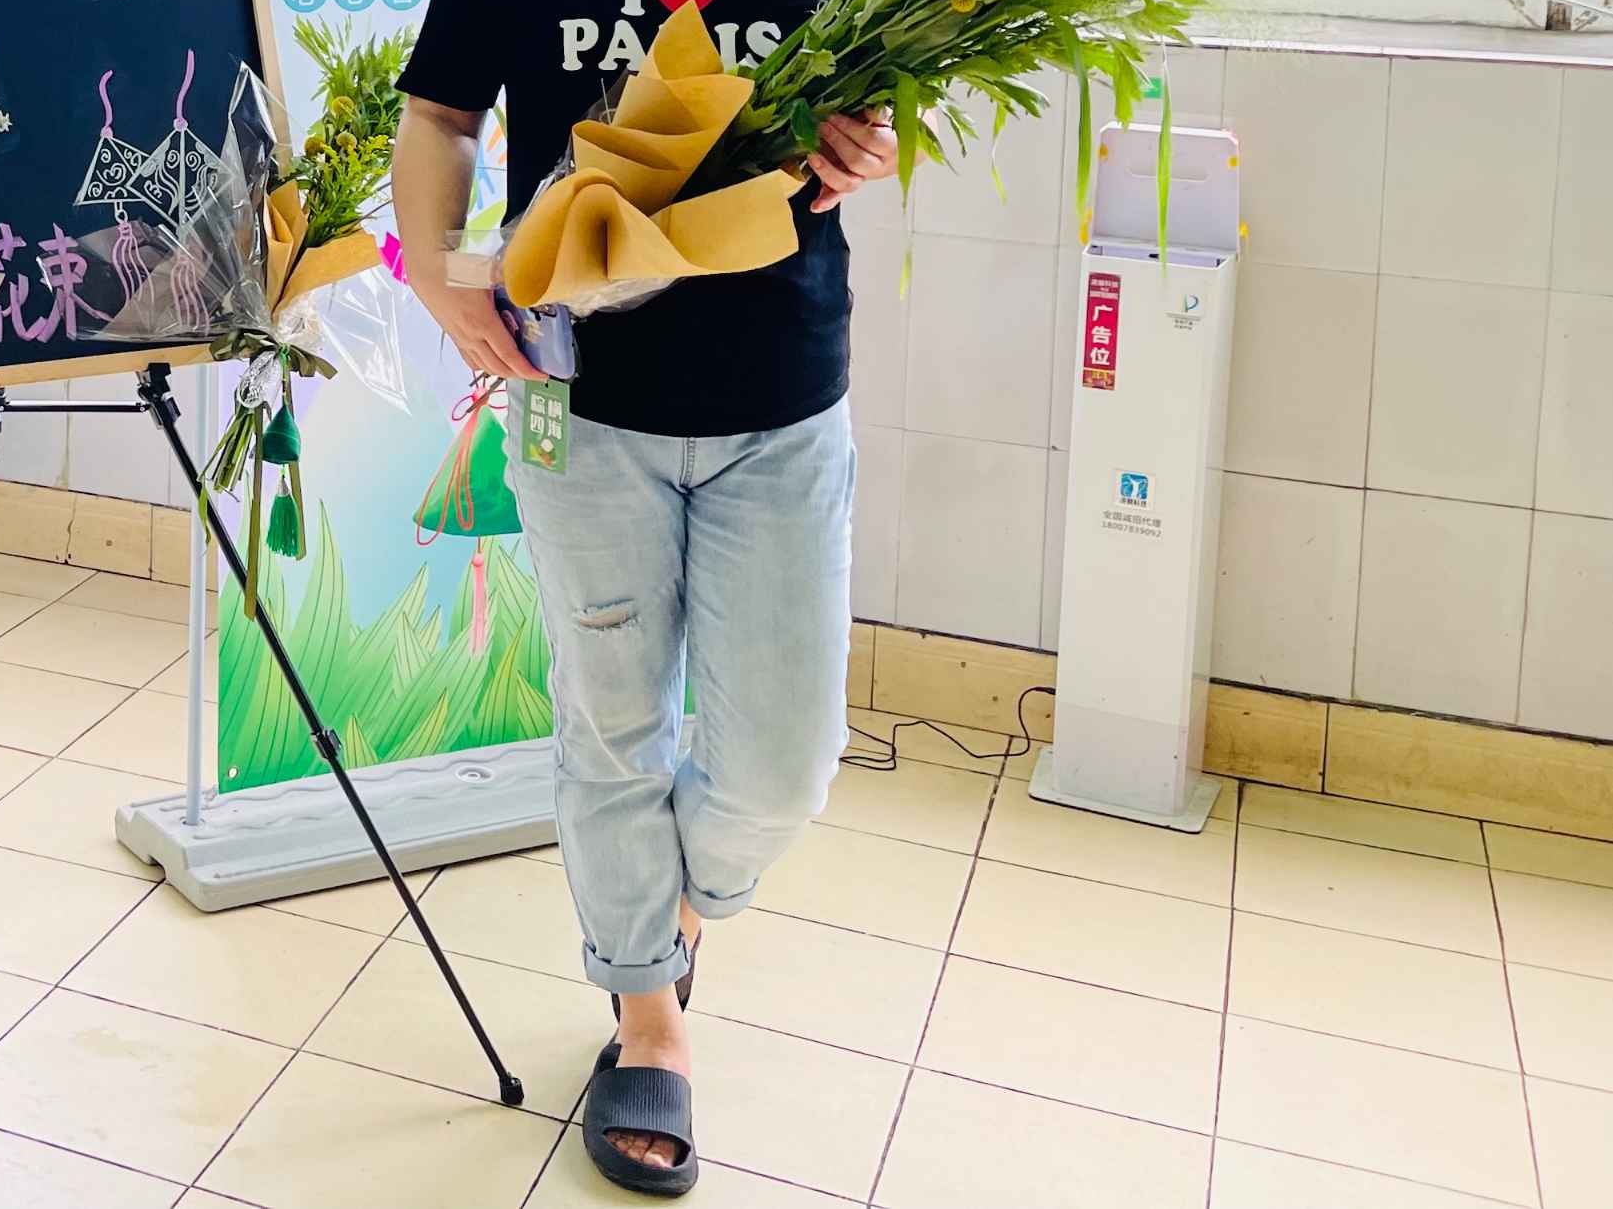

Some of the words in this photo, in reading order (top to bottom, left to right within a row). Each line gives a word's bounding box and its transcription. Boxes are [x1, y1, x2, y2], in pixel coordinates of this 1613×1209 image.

[559, 18, 782, 74] PAIS
[1090, 304, 1114, 366] 广告位
